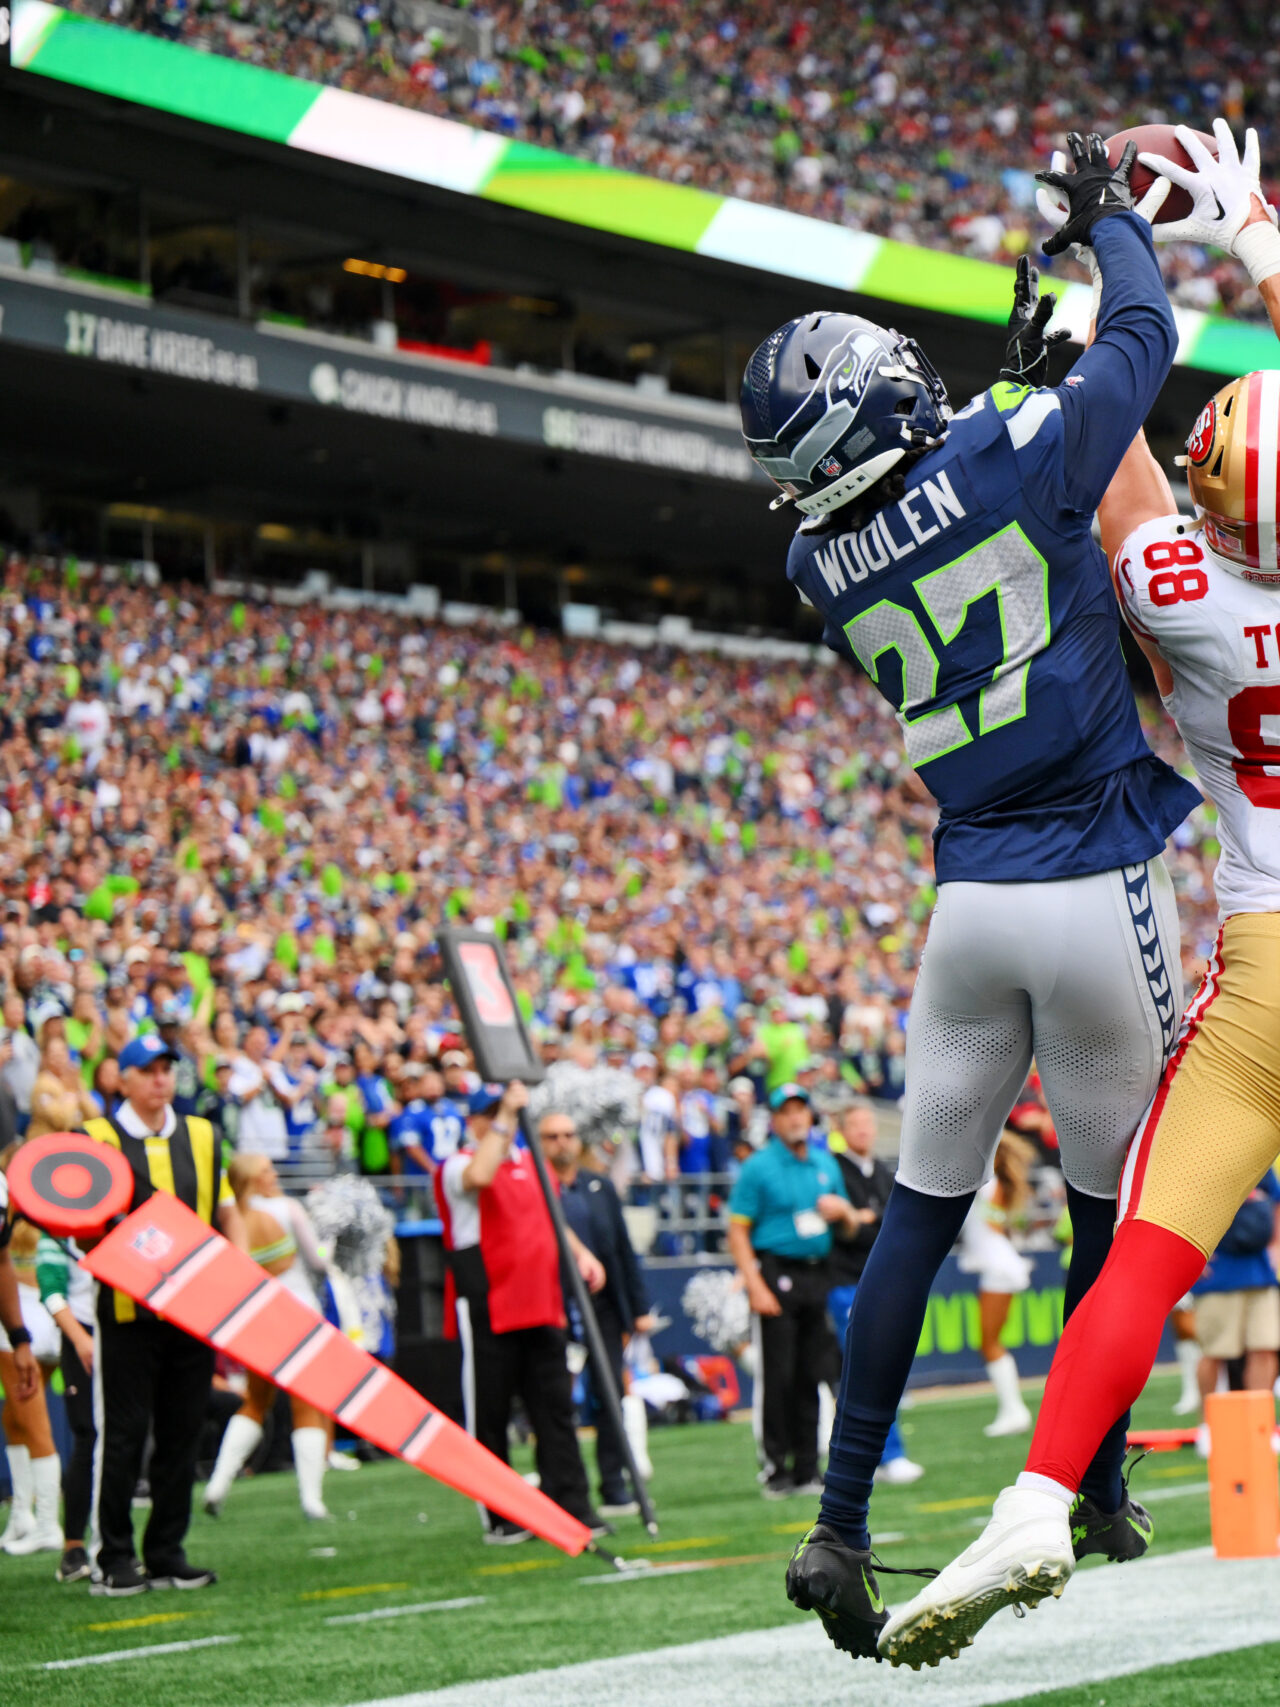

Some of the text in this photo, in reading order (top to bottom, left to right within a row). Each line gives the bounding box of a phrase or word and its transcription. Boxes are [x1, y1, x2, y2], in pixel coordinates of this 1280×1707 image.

[813, 470, 967, 597] WOOLEN
[1142, 539, 1209, 607] 88
[843, 520, 1051, 769] 27
